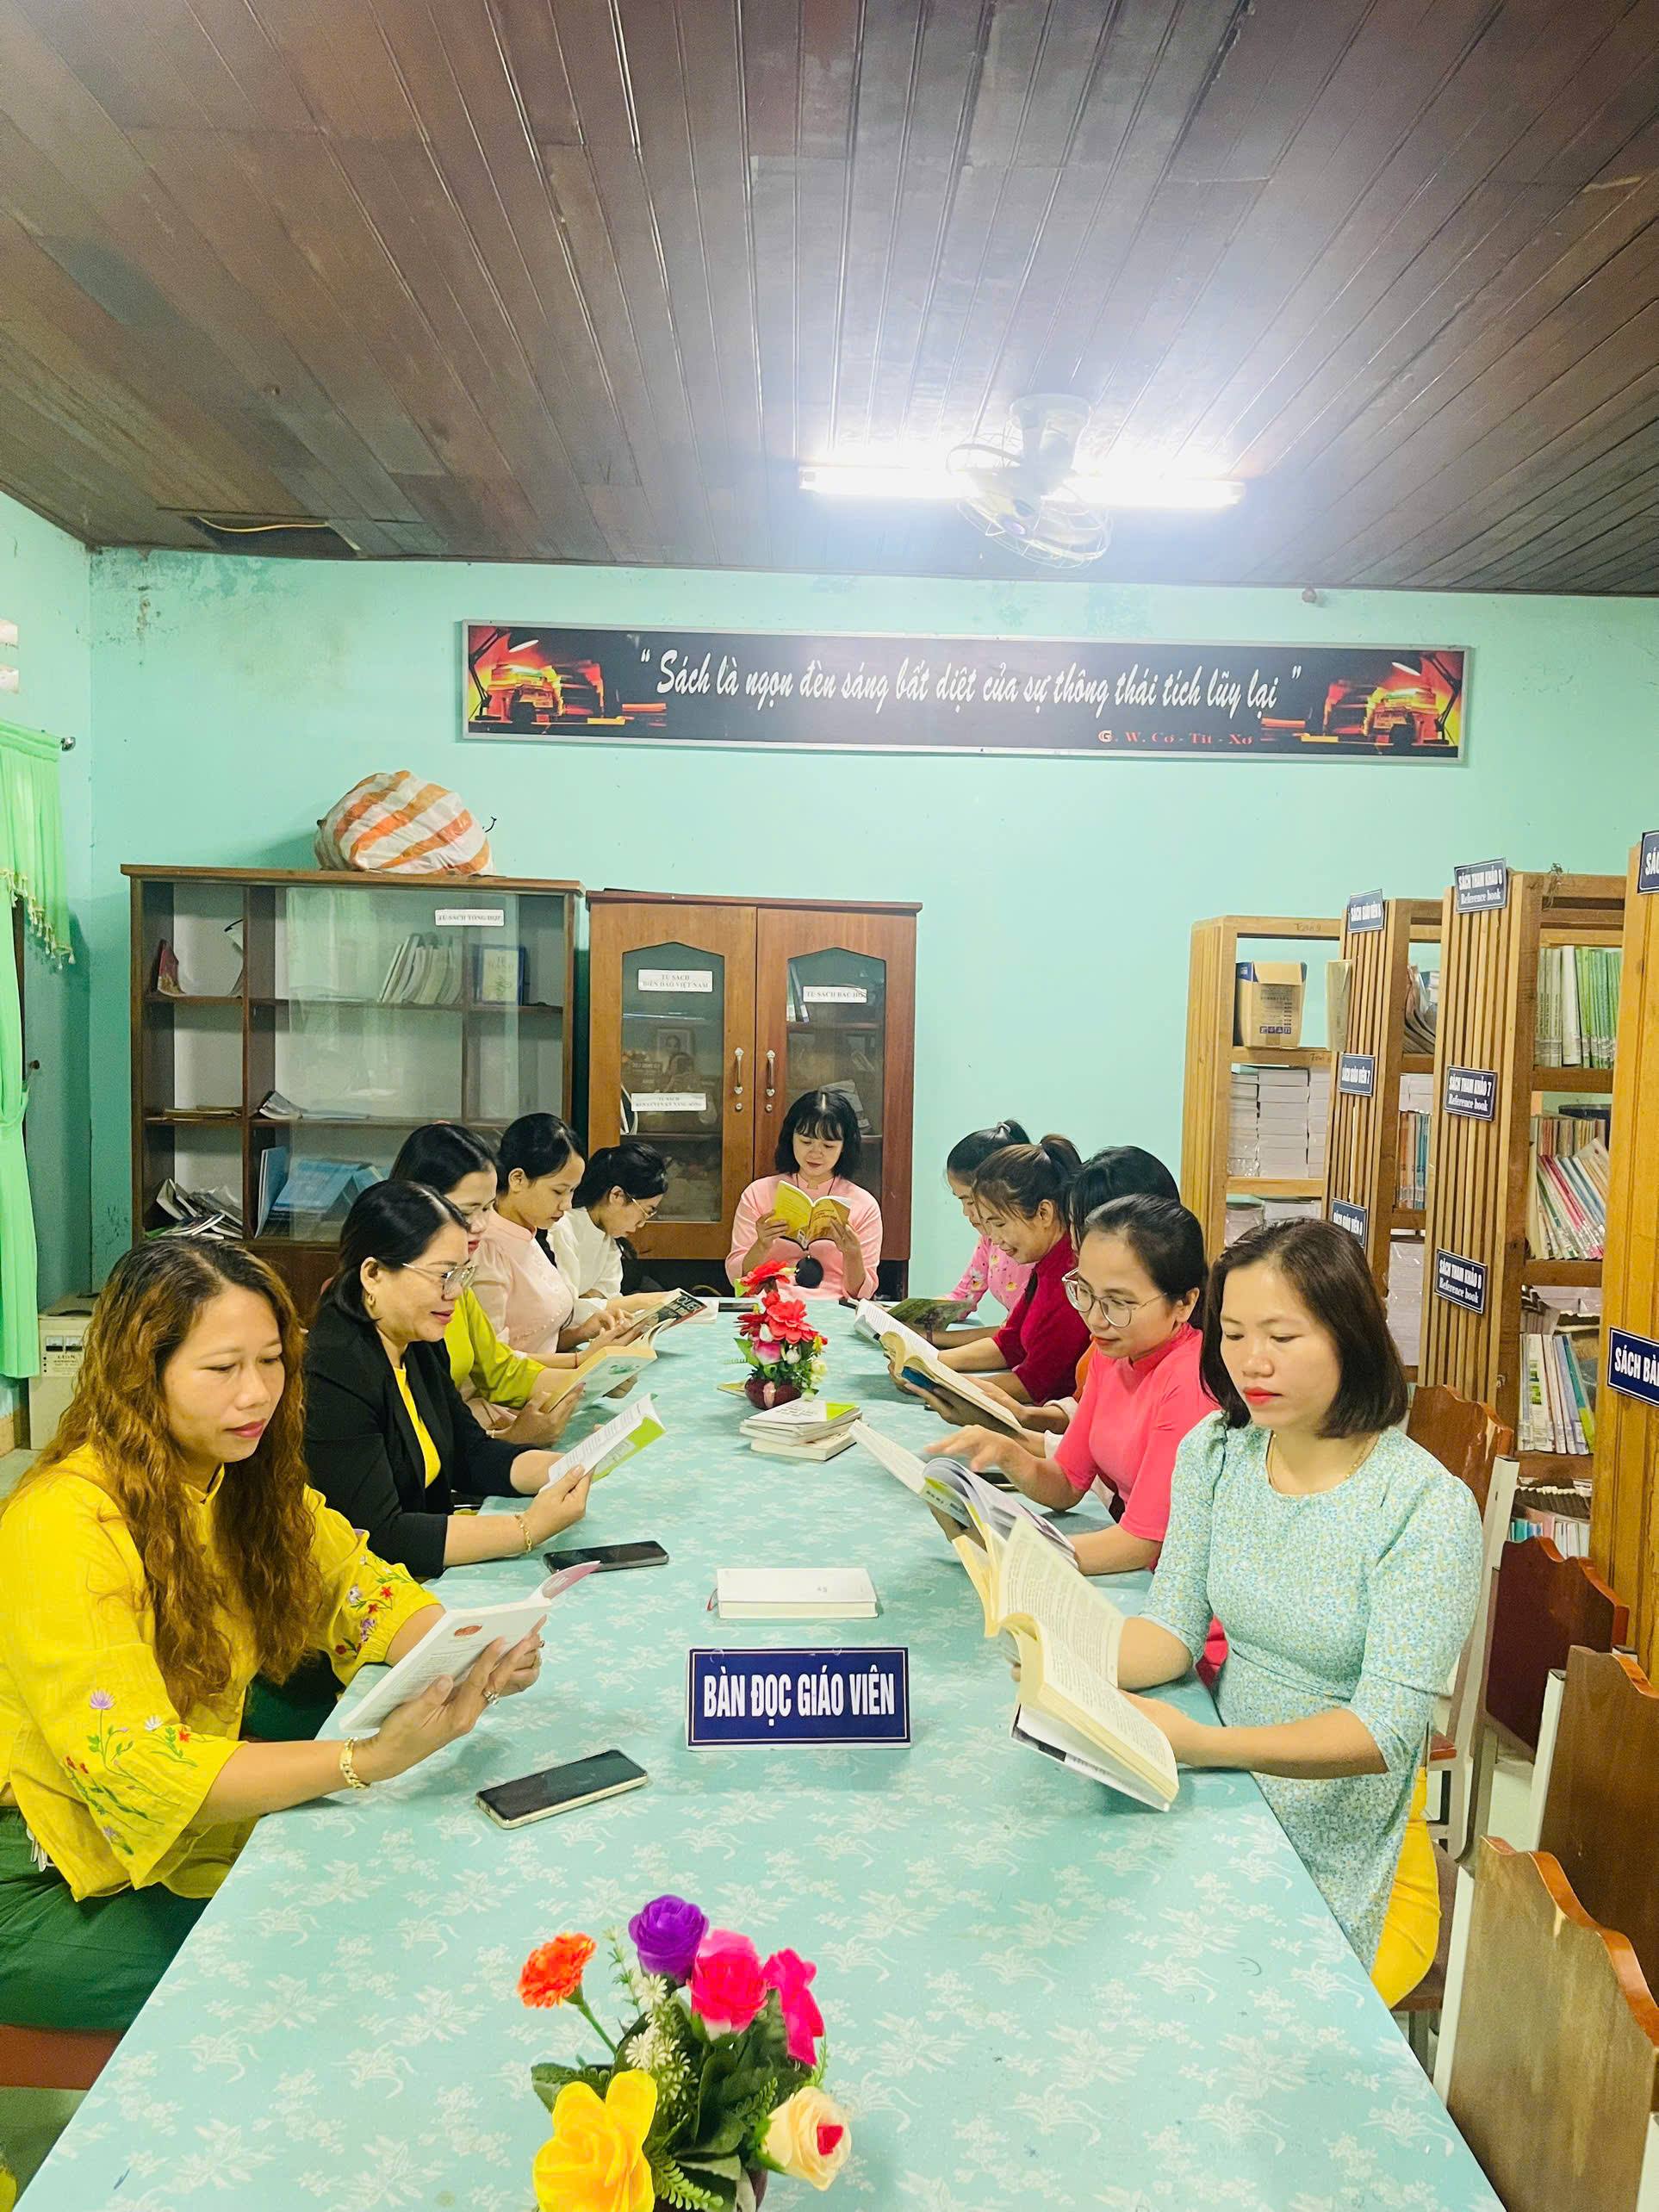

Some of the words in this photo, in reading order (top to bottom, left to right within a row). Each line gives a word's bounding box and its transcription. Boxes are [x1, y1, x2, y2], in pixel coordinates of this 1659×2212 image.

[657, 649, 711, 694] Sách
[717, 655, 741, 696] là
[746, 670, 793, 711] ngọn
[800, 660, 836, 699] đèn
[842, 662, 890, 714] sáng
[896, 657, 930, 701] bất
[936, 662, 977, 714] diệt
[983, 662, 1019, 703] của
[1022, 674, 1052, 714] sự
[1053, 662, 1110, 719] thông
[1115, 663, 1157, 706] thái
[1163, 666, 1202, 707] tích
[1208, 668, 1241, 719] lũy
[1247, 669, 1279, 719] lại
[1461, 892, 1487, 904] Reference
[1487, 888, 1501, 901] book
[1449, 1073, 1461, 1091] SÁCH
[1488, 1081, 1492, 1097] 7
[1448, 1093, 1474, 1109] Reference
[1474, 1097, 1488, 1112] book
[1438, 1258, 1451, 1277] SÁCH
[1438, 1277, 1464, 1298] Reference
[1464, 1287, 1479, 1304] book
[1614, 1344, 1642, 1380] SÁCH
[1643, 1354, 1659, 1387] BÀ
[703, 1666, 746, 1718] BÀN
[750, 1673, 792, 1727] ĐỌC
[797, 1664, 844, 1718] GIÁO
[848, 1663, 895, 1716] VIÊN
